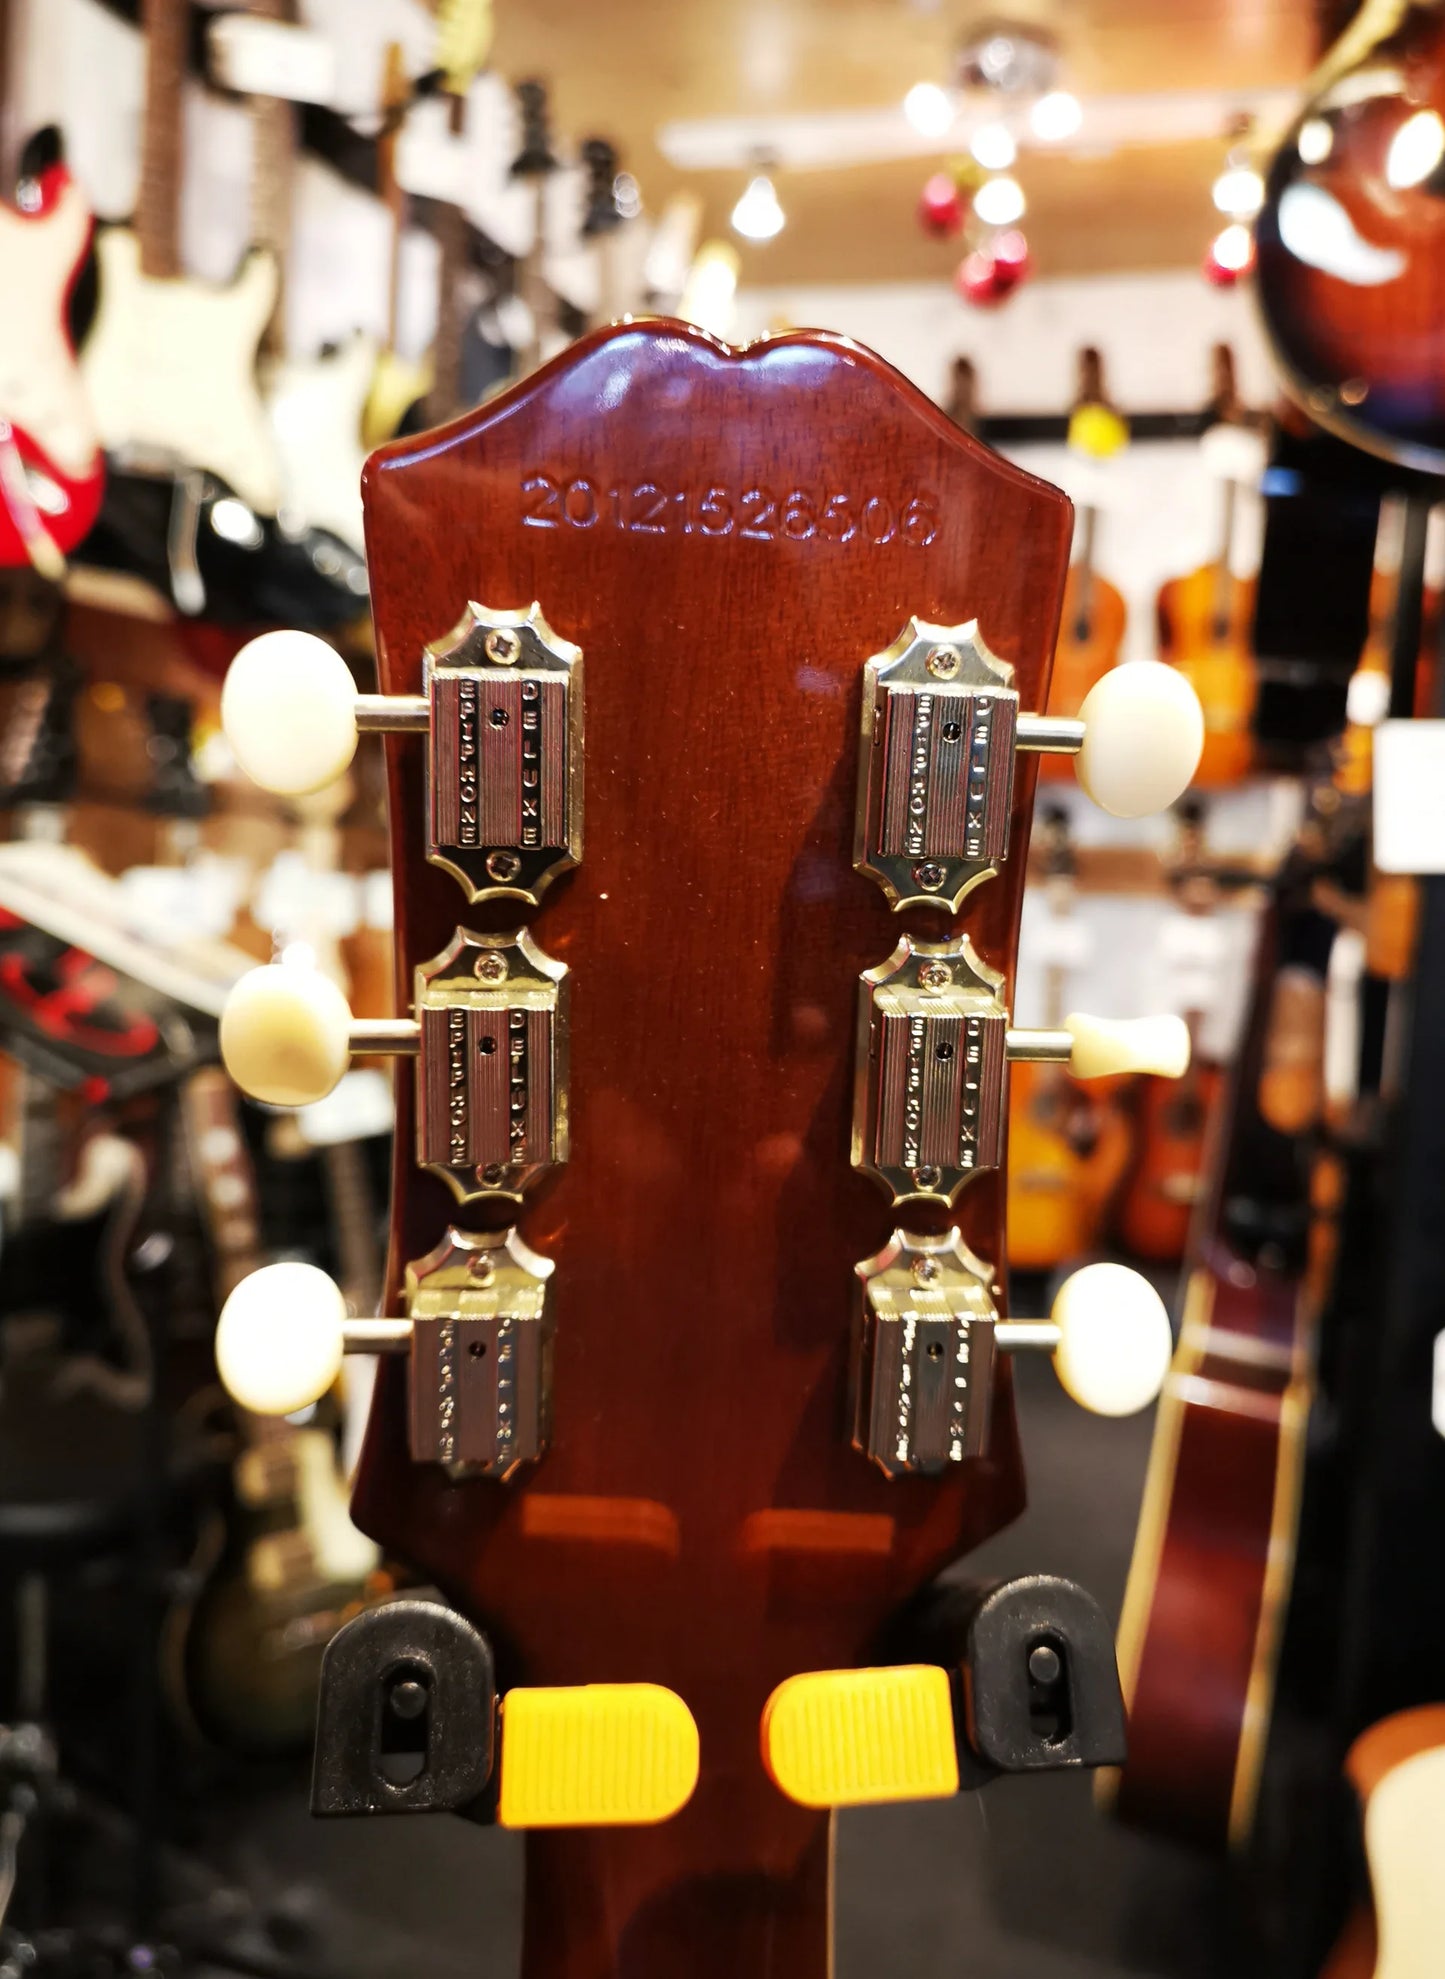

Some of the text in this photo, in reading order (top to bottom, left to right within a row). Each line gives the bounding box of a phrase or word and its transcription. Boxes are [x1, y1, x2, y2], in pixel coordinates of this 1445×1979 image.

[521, 474, 938, 547] 20121526506
[459, 679, 478, 844] EPIPHONE
[522, 681, 539, 845] DELUXE
[908, 694, 931, 855] EPIPHONE
[966, 697, 991, 857] DELUXE
[449, 1012, 466, 1165] EPIPHONE
[510, 1012, 526, 1164] DELUXE
